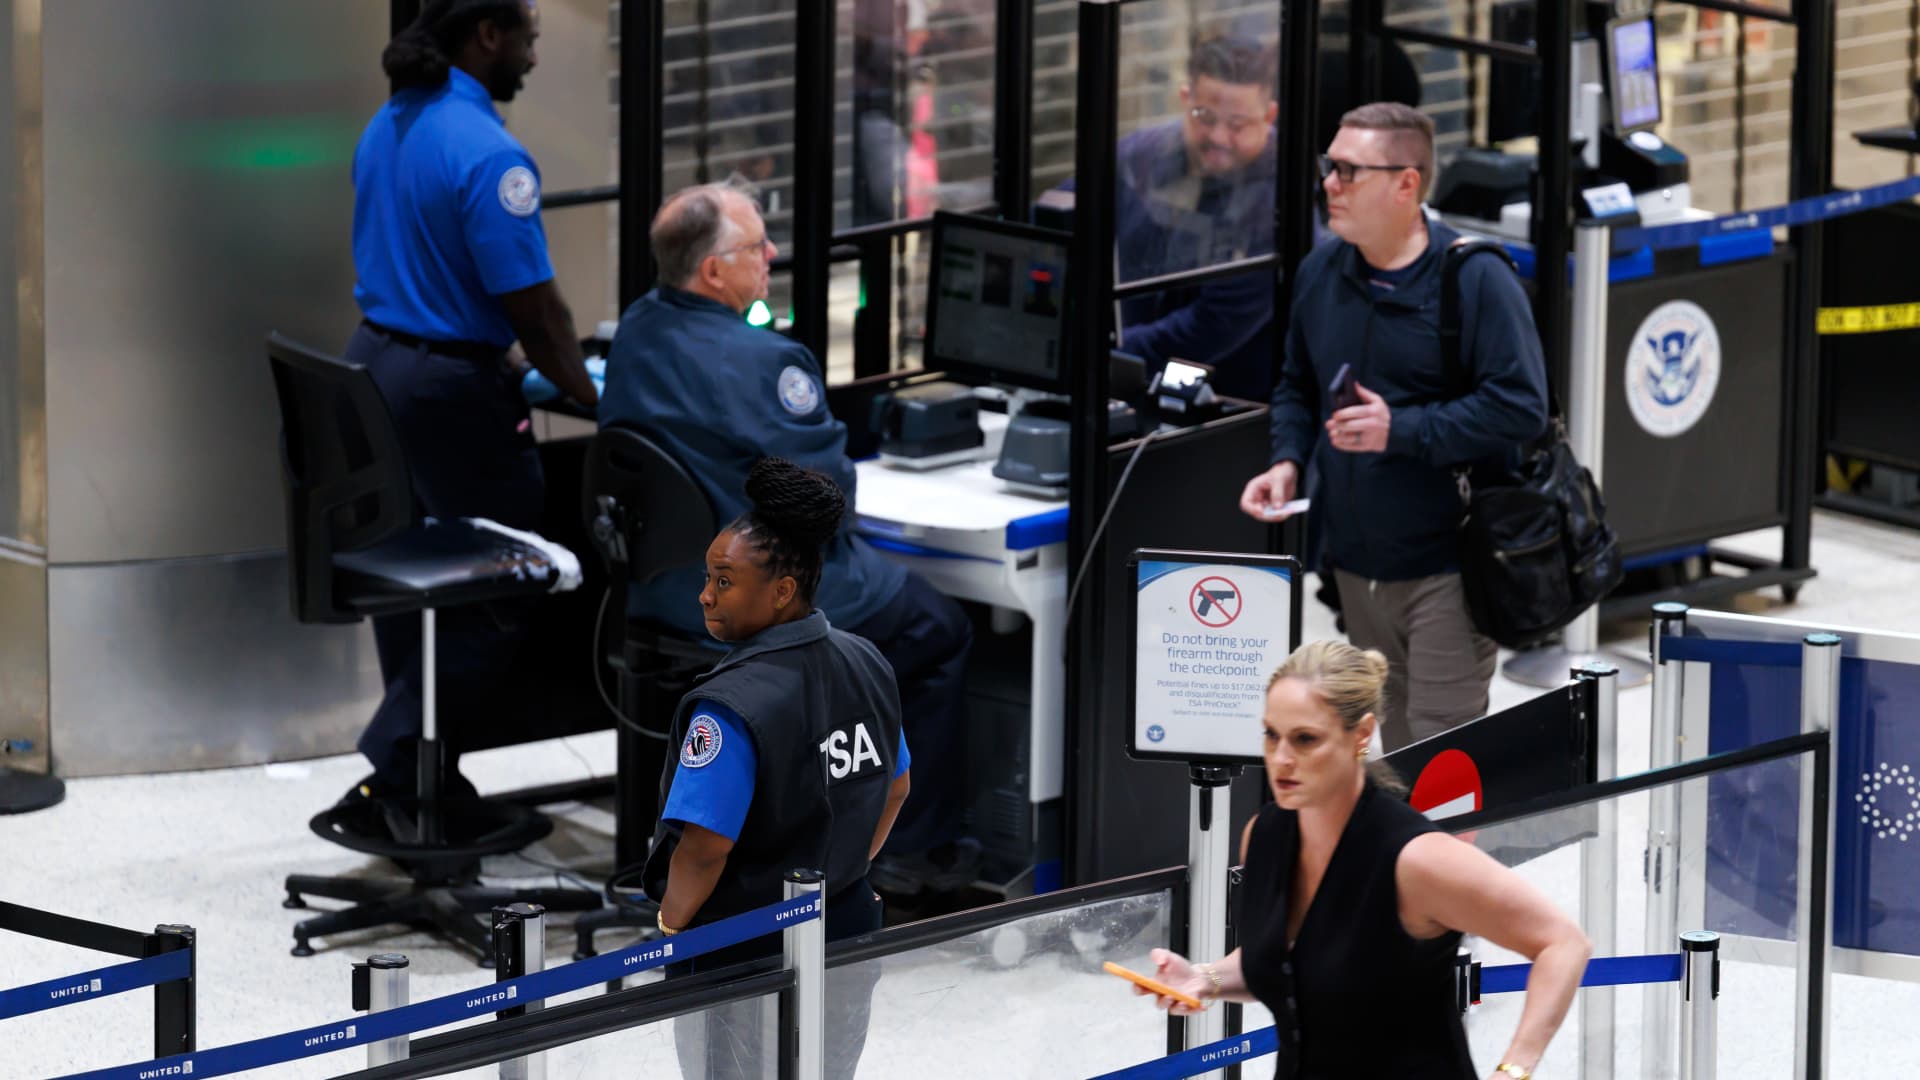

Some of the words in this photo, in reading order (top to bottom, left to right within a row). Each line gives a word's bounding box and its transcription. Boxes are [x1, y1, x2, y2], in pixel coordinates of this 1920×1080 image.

[1162, 632, 1179, 644] Do
[1182, 634, 1202, 645] not
[1205, 634, 1237, 648] bring
[1240, 638, 1269, 649] your
[1167, 647, 1212, 659] firearm
[1215, 649, 1263, 663] through
[1169, 661, 1189, 673] the
[1191, 663, 1260, 677] checkpoint.
[1156, 679, 1190, 689] Potential
[1191, 681, 1209, 689] fines
[1210, 683, 1221, 691] up
[1221, 682, 1230, 690] to
[1184, 690, 1240, 700] disqualification
[1241, 692, 1260, 700] from
[775, 904, 813, 921] UNITED
[623, 949, 662, 966] UNITED
[50, 984, 89, 999] UNITED
[466, 991, 506, 1008] UNITED
[304, 1031, 345, 1047] UNITED
[1201, 1046, 1240, 1062] UNITED
[139, 1065, 181, 1080] UNITED
